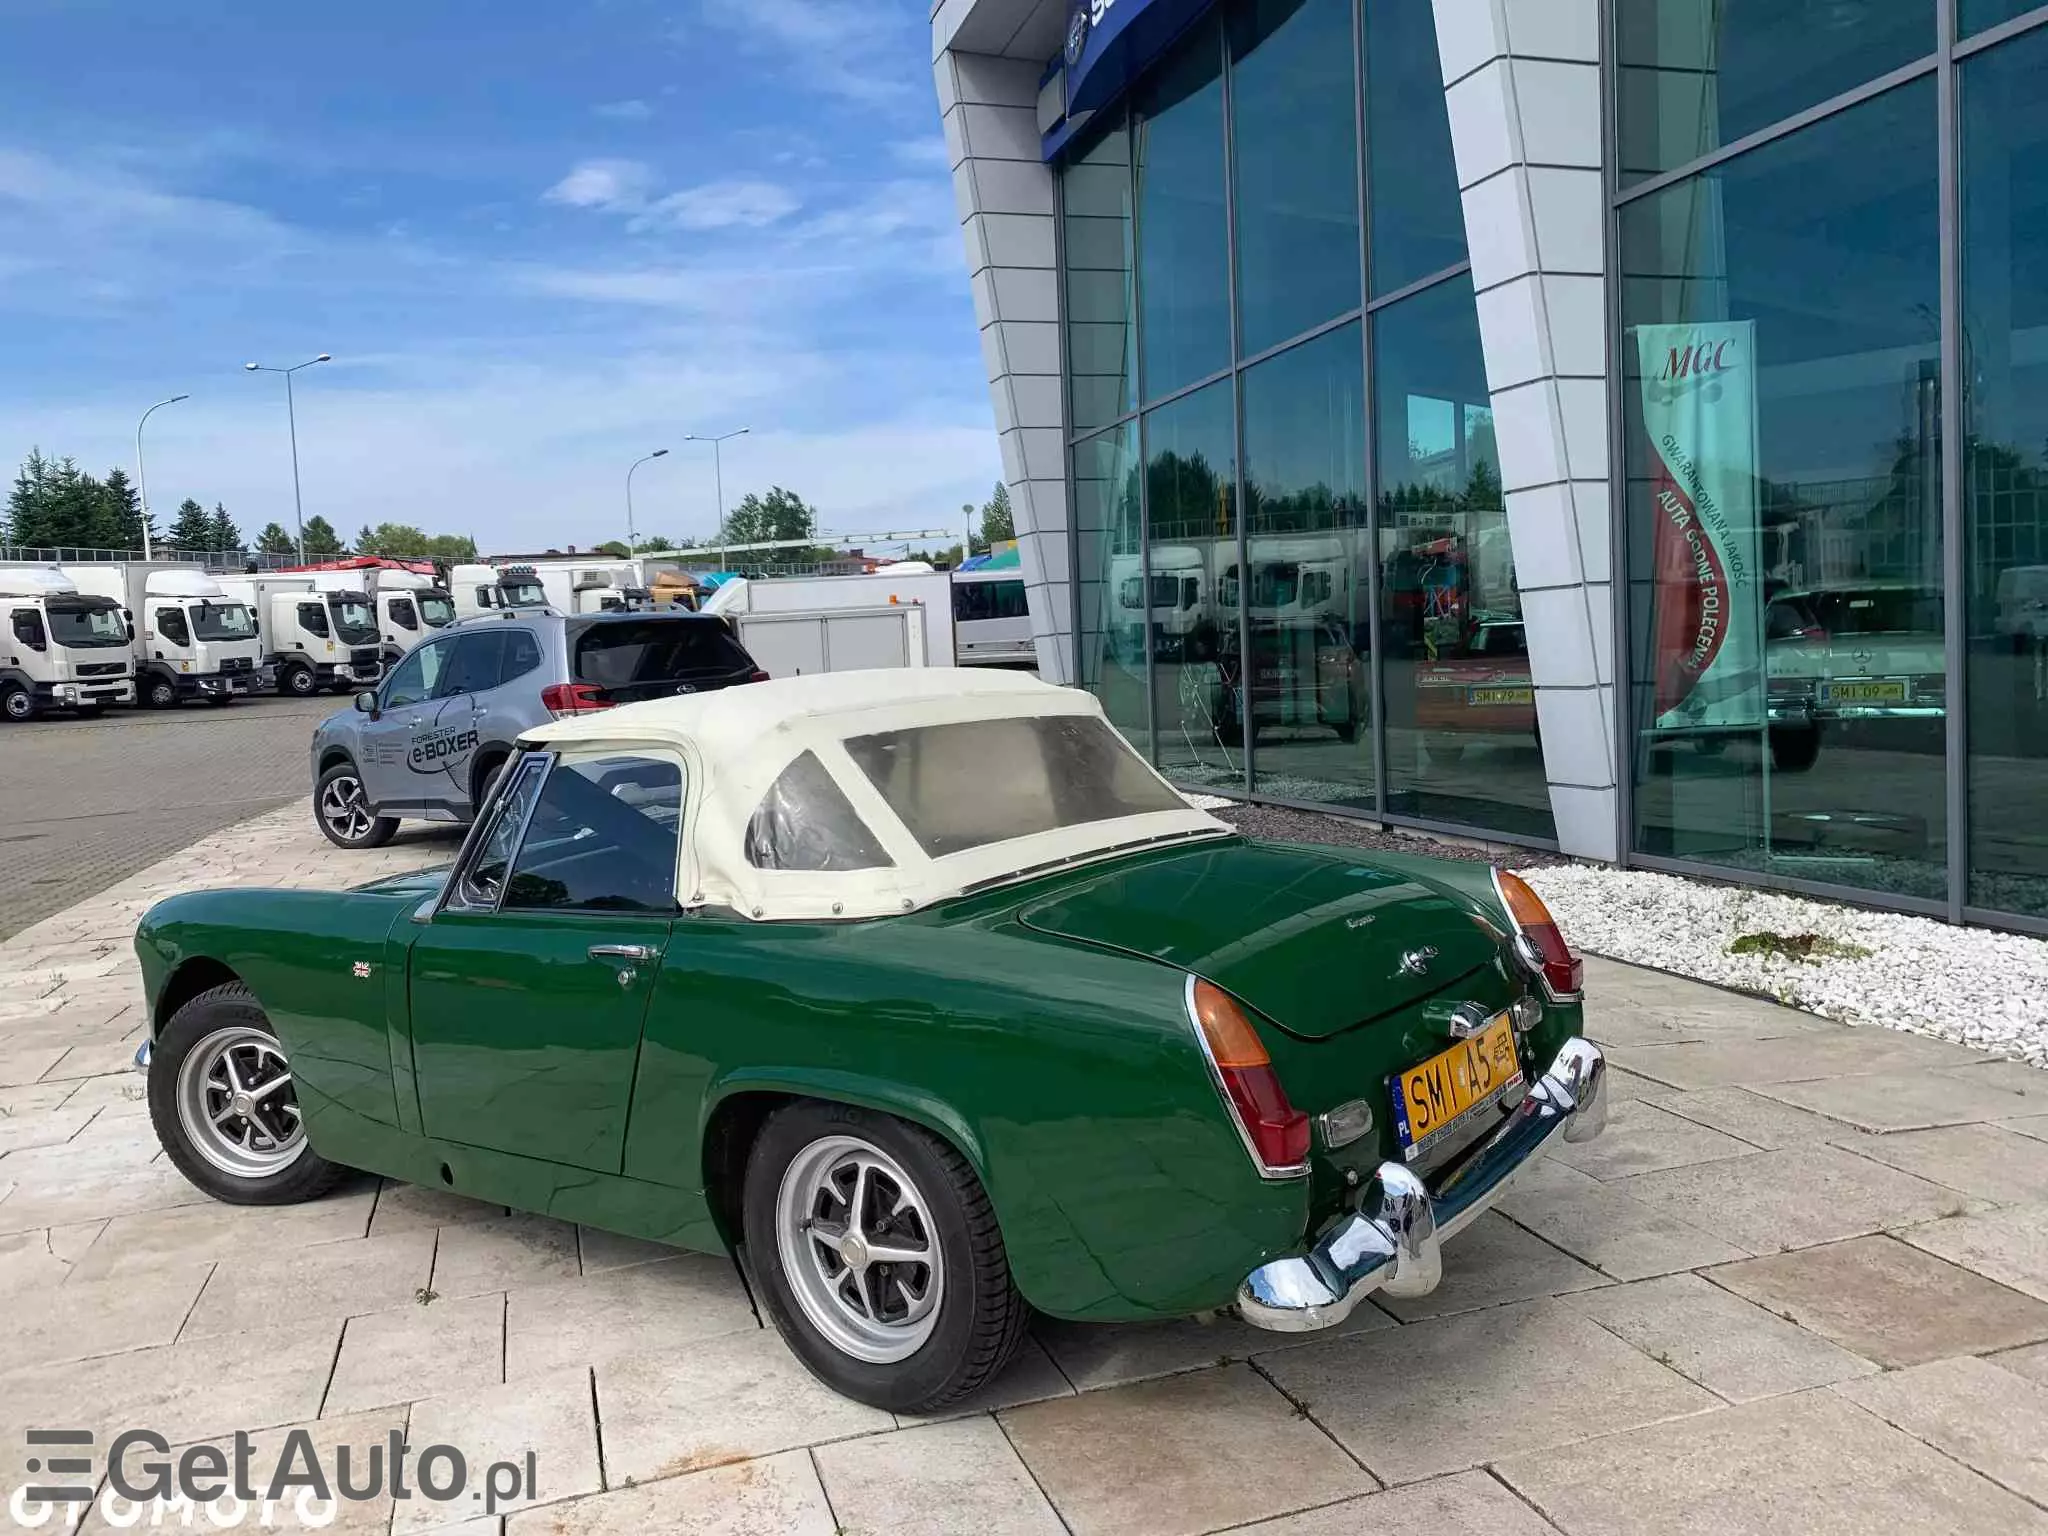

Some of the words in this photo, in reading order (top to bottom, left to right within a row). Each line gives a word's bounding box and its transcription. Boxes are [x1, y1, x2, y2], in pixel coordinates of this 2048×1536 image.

[1662, 338, 1737, 380] MGC
[1662, 434, 1730, 541] GWARANTOWANA
[1656, 490, 1690, 530] AUTA
[1686, 528, 1714, 584] GODNE
[1687, 586, 1719, 669] POLECENIA
[411, 726, 456, 744] FORESTER
[412, 729, 480, 763] e-BOXER
[1411, 1057, 1457, 1129] SMI
[1466, 1037, 1491, 1099] A5
[1398, 1119, 1410, 1138] PL
